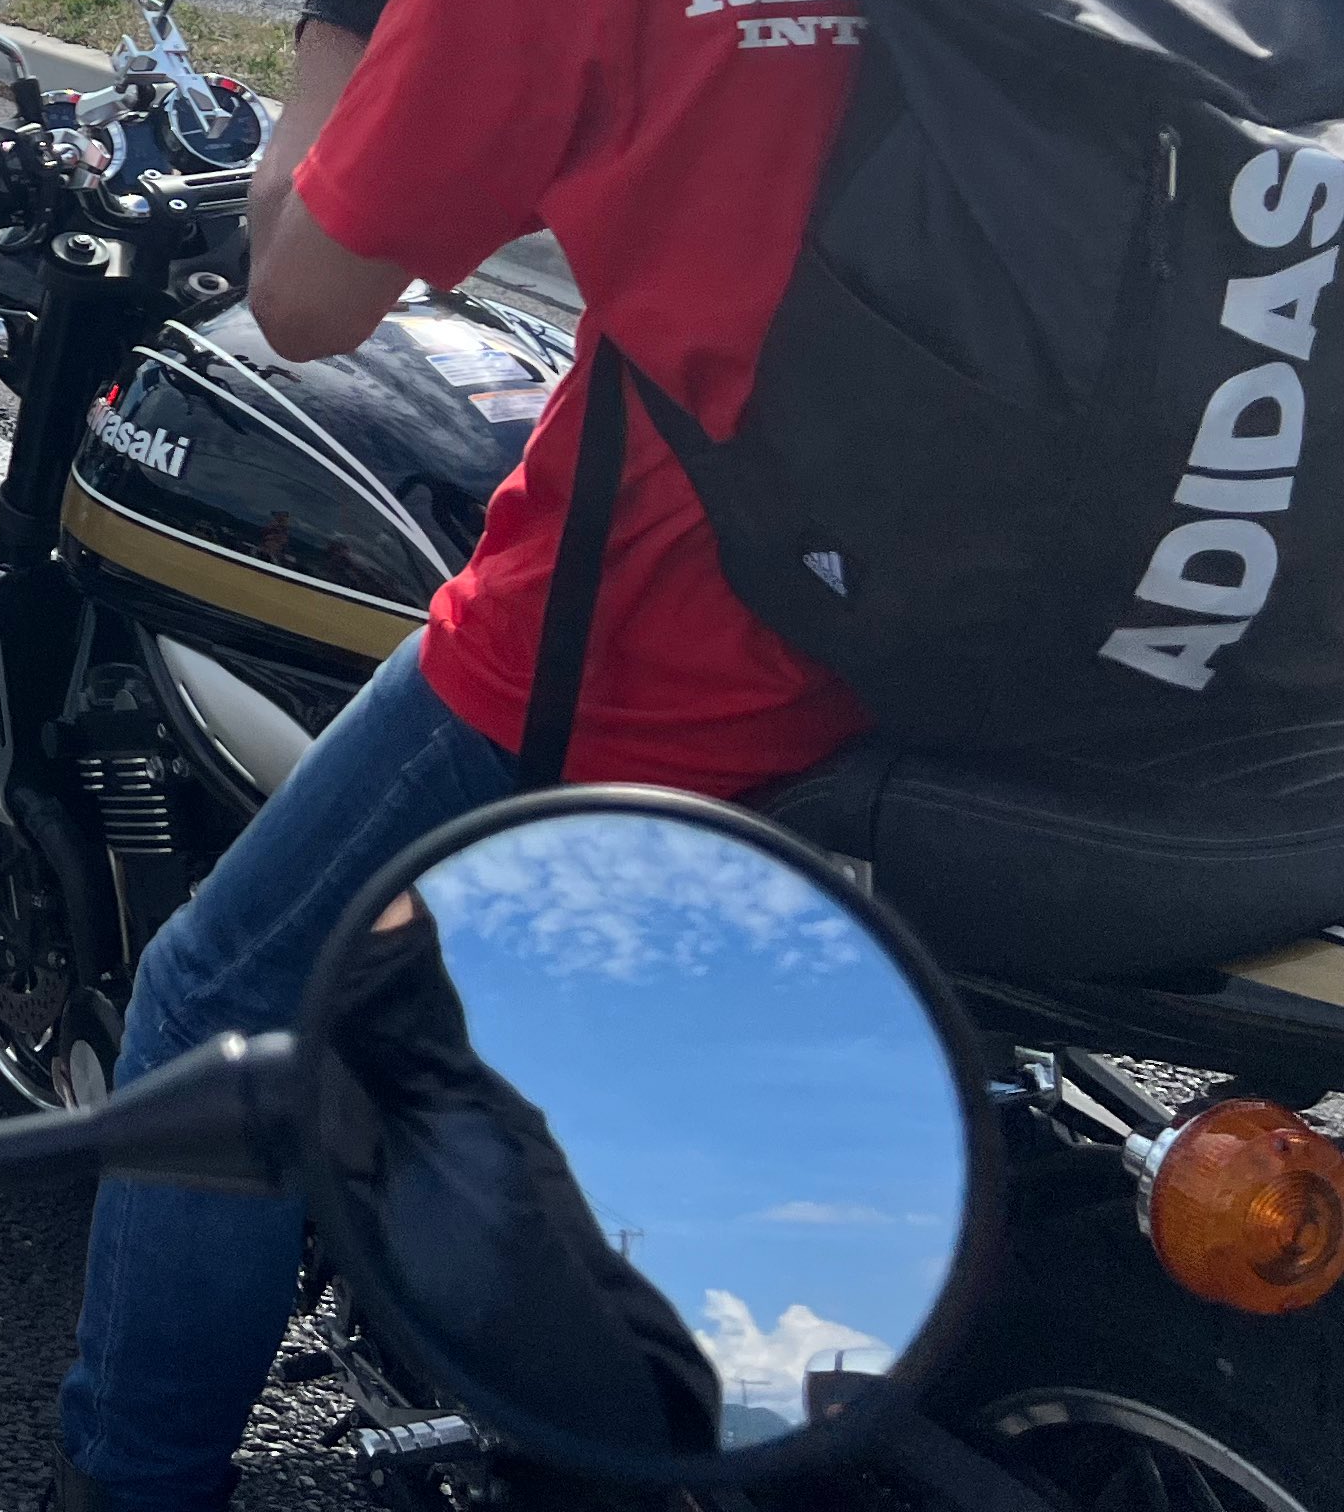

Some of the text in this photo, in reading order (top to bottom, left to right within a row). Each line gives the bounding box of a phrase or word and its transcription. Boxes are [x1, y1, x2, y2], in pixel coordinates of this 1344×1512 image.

[736, 15, 868, 49] INT
[87, 404, 191, 478] wasaki
[1098, 147, 1344, 691] ADIDAS
